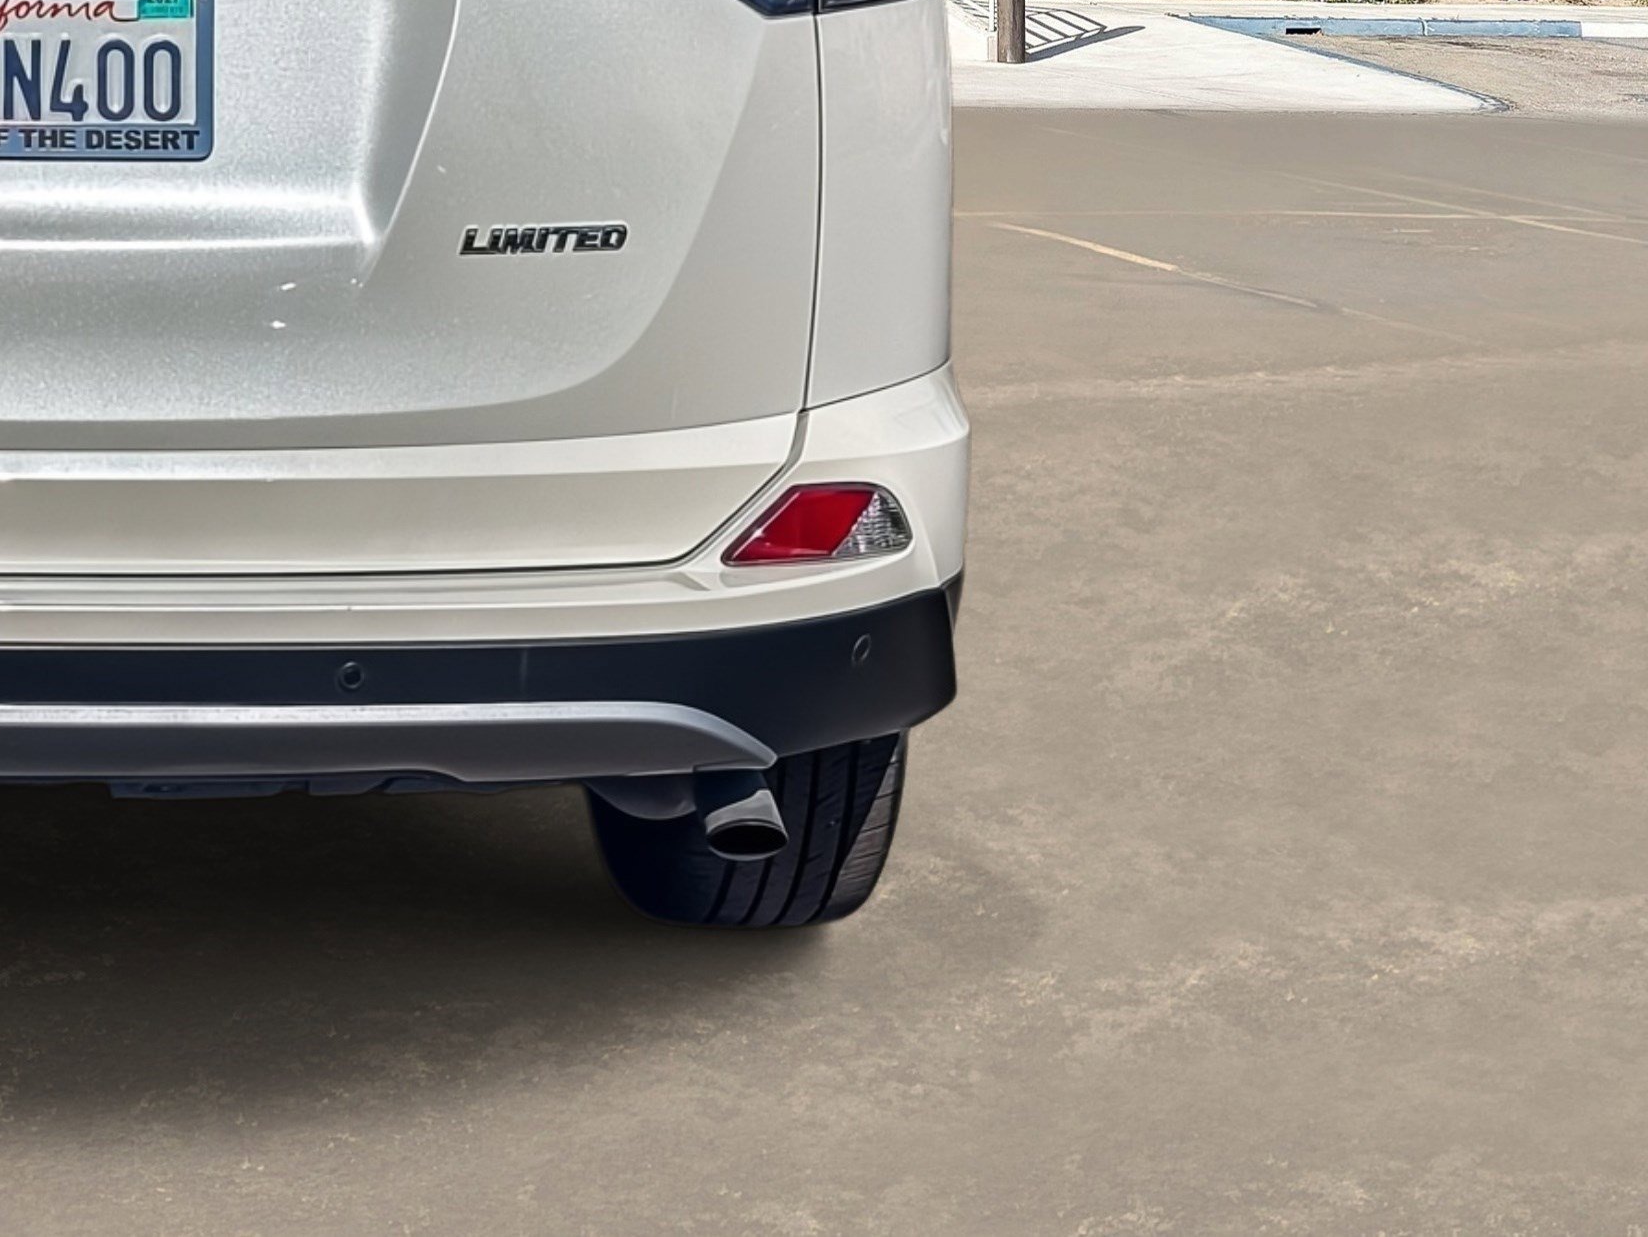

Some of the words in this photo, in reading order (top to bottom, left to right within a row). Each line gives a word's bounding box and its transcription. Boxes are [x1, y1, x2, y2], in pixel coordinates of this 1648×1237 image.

[18, 128, 77, 150] THE
[85, 129, 200, 151] DESERT
[459, 223, 628, 255] LIMITED
